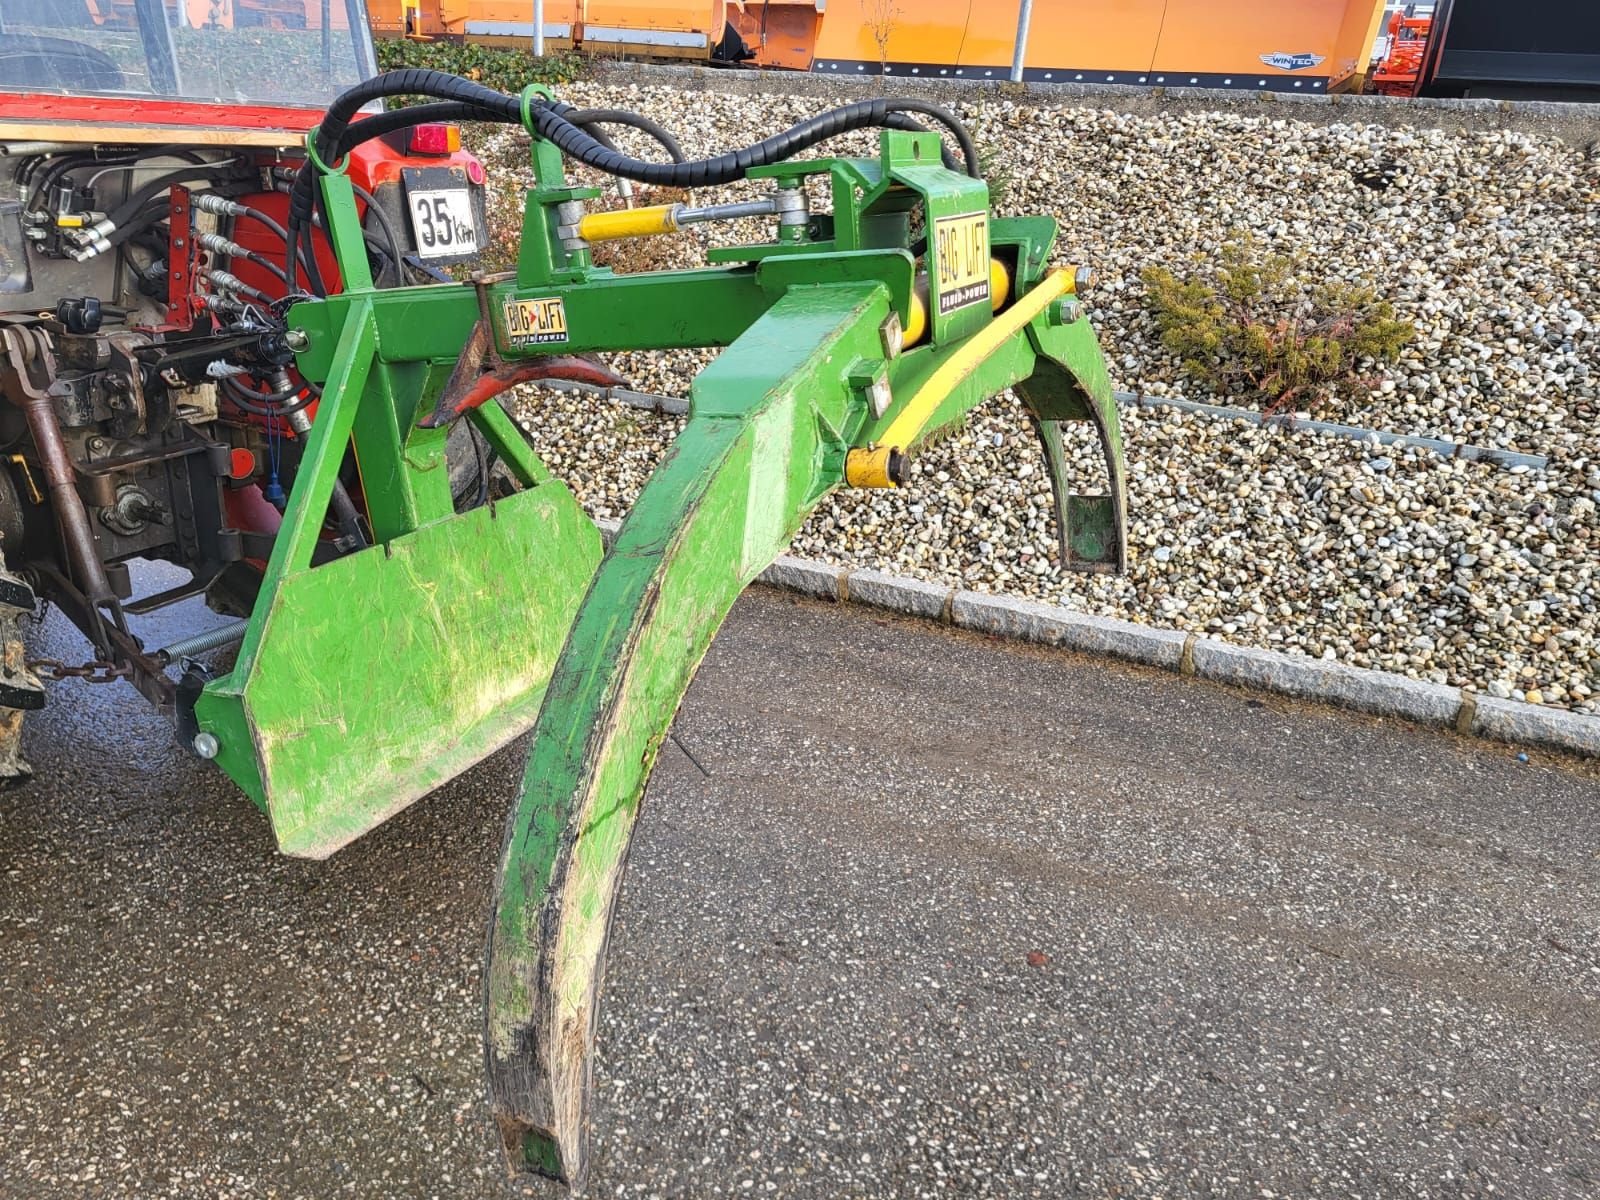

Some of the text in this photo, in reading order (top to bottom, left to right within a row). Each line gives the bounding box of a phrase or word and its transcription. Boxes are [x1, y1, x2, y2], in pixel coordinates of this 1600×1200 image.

[1272, 57, 1313, 65] WINTEC
[417, 197, 452, 248] 35
[939, 221, 986, 285] BIG LIFT
[942, 284, 987, 308] FLUID-POWER
[508, 301, 563, 331] BIG LIFT
